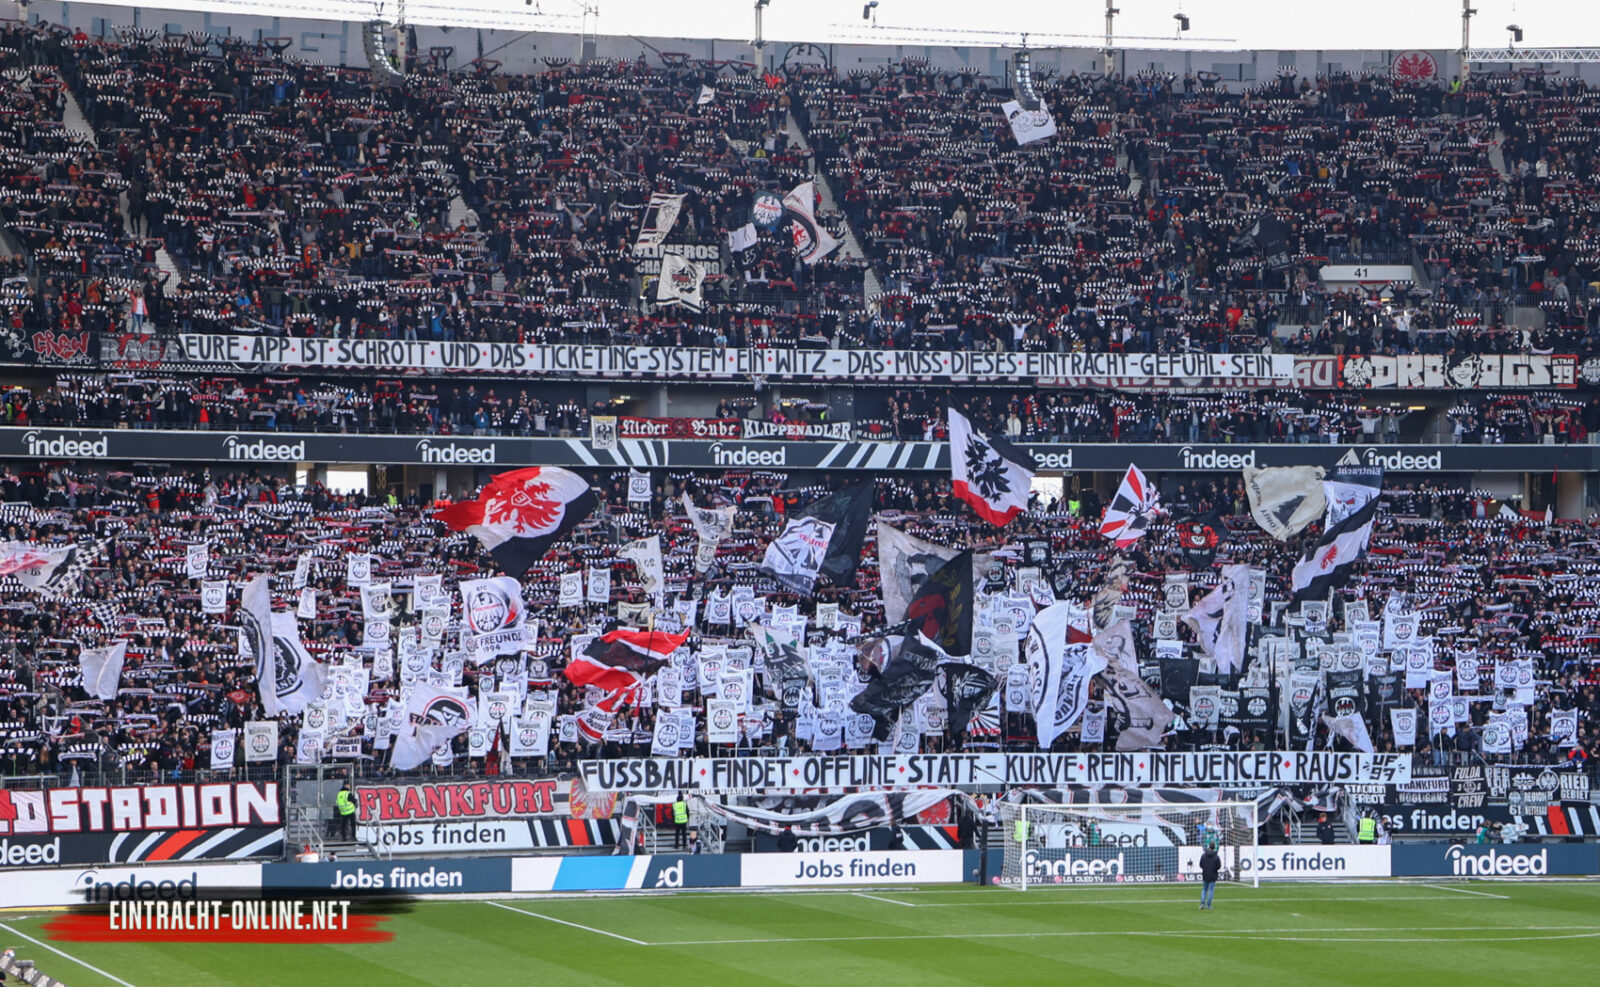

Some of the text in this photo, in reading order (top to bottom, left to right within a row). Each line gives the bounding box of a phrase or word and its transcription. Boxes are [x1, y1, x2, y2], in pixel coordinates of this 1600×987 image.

[1354, 268, 1368, 277] 41
[32, 330, 90, 360] CREW
[186, 336, 240, 361] EURE
[251, 337, 290, 363] APP
[300, 339, 329, 363] IST
[337, 339, 430, 366] SCHROTT
[440, 342, 480, 367] UND
[491, 344, 526, 368] DAS
[536, 345, 726, 373] TICKETING-SYSTEM
[737, 348, 765, 373] EIN
[775, 349, 826, 373] WITZ
[848, 350, 885, 373] DAS
[895, 351, 943, 374] MUSS
[951, 352, 1017, 375] DIESES
[1231, 354, 1288, 378] SEIN...
[1552, 366, 1575, 384] 99
[621, 417, 736, 437] Nieder Bube
[742, 419, 852, 441] KLIPPENADLER
[23, 432, 107, 457] indeed
[223, 436, 305, 461] indeed
[416, 439, 495, 463] indeed
[708, 442, 786, 466] indeed
[1029, 448, 1072, 469] eed
[1178, 446, 1255, 469] indeed
[1363, 447, 1441, 470] indeed
[480, 632, 522, 648] FREUNDE
[583, 759, 700, 789] FUSSBALL
[712, 758, 792, 788] FINDET
[803, 757, 896, 787] OFFLINE
[908, 755, 980, 784] STATT
[1006, 755, 1077, 784] KURVE
[1088, 754, 1142, 783] REIN,
[1150, 753, 1283, 783] INFLUENCER
[1296, 752, 1360, 782] RAUS!
[1373, 755, 1399, 766] UF
[1369, 767, 1396, 781] 97
[1454, 766, 1480, 779] FULDA
[1561, 774, 1589, 789] RIED
[355, 781, 555, 820] FRANKFURT
[1350, 793, 1386, 804] ERBOT
[1399, 792, 1448, 804] HOOLIGANS
[1457, 795, 1484, 808] CREW
[1560, 789, 1589, 800] GEBIET
[1410, 809, 1485, 830] finden
[1509, 804, 1521, 816] 61
[432, 822, 503, 844] finden
[797, 831, 870, 851] ndeed
[795, 857, 916, 878] Jobs finden
[1022, 849, 1123, 876] indeed
[1281, 852, 1345, 871] finden
[1445, 845, 1547, 875] indeed
[75, 869, 197, 902] indeed
[331, 866, 462, 889] Jobs finden
[1033, 875, 1043, 883] TV
